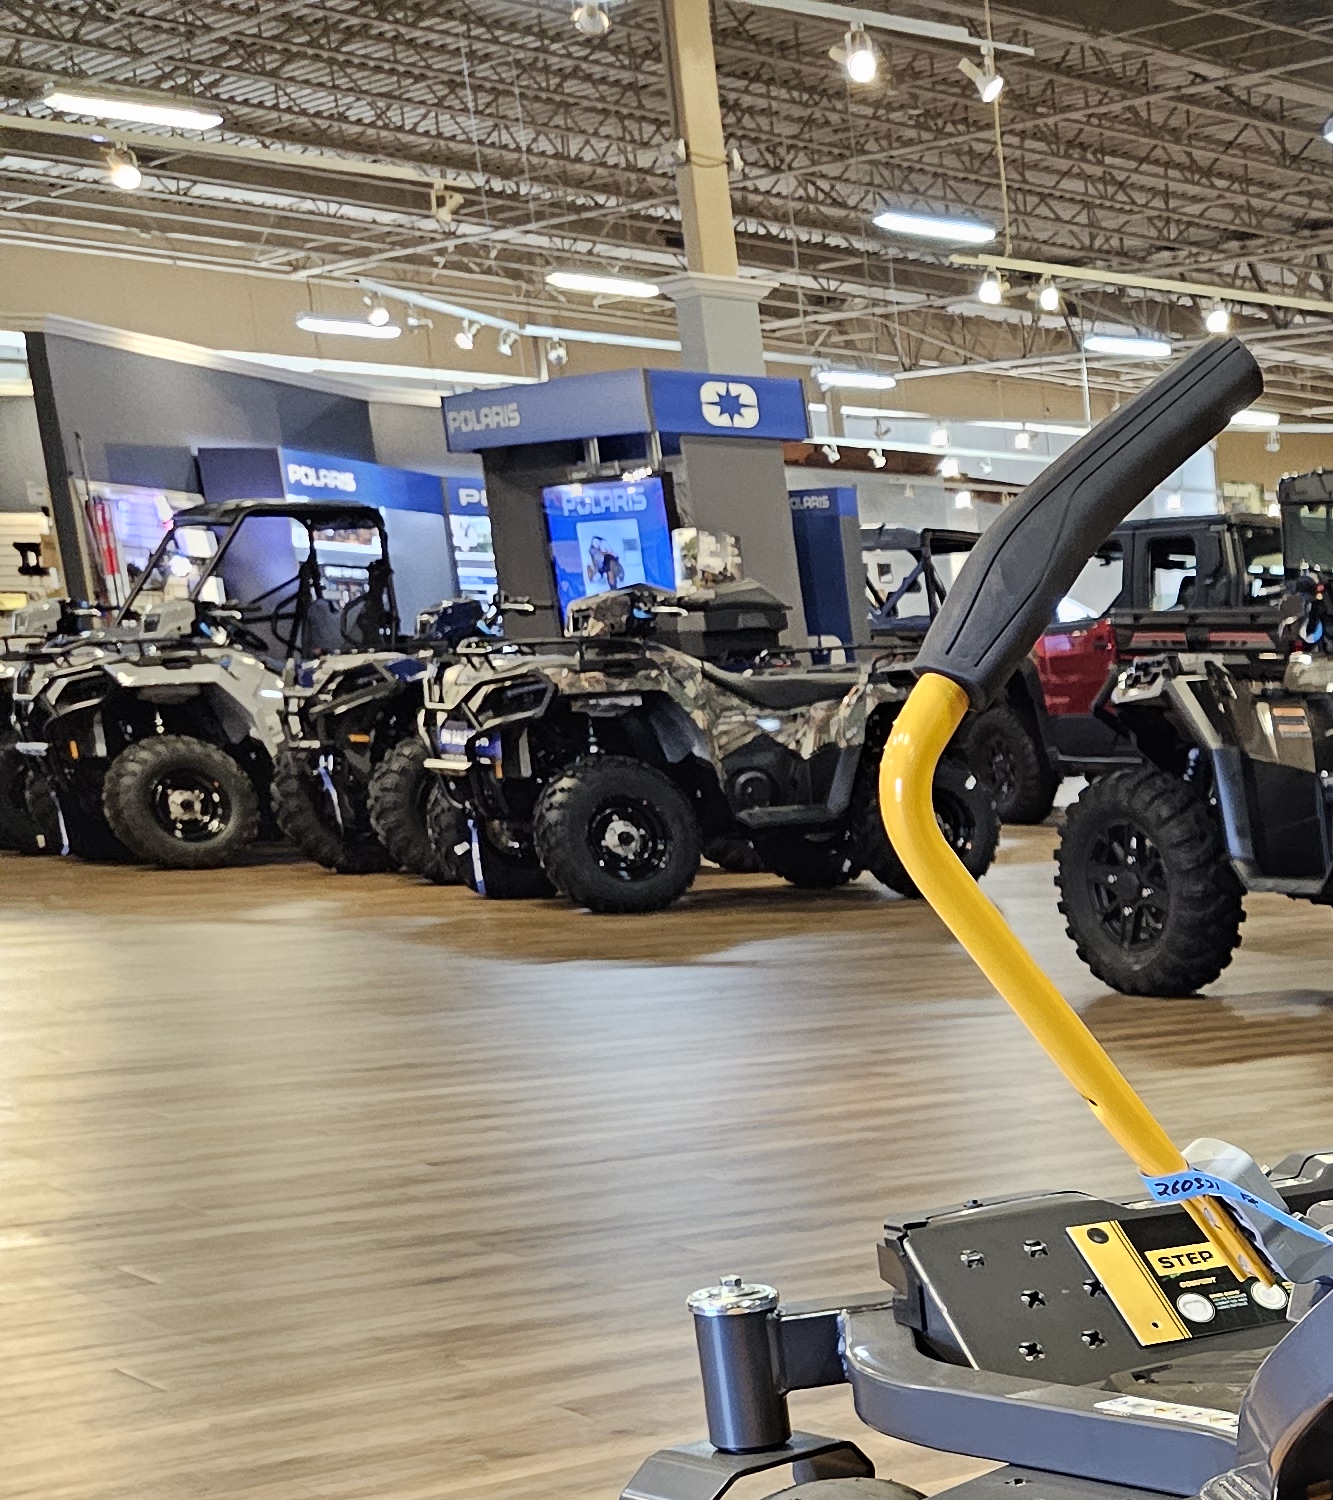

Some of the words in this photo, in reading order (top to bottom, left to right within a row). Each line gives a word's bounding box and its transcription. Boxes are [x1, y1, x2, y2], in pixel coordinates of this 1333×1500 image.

[447, 402, 521, 433] POLARIS
[287, 463, 357, 492] POLARIS
[561, 485, 647, 516] POLARIS
[789, 495, 830, 510] OLARIS
[1157, 1250, 1214, 1269] STEP
